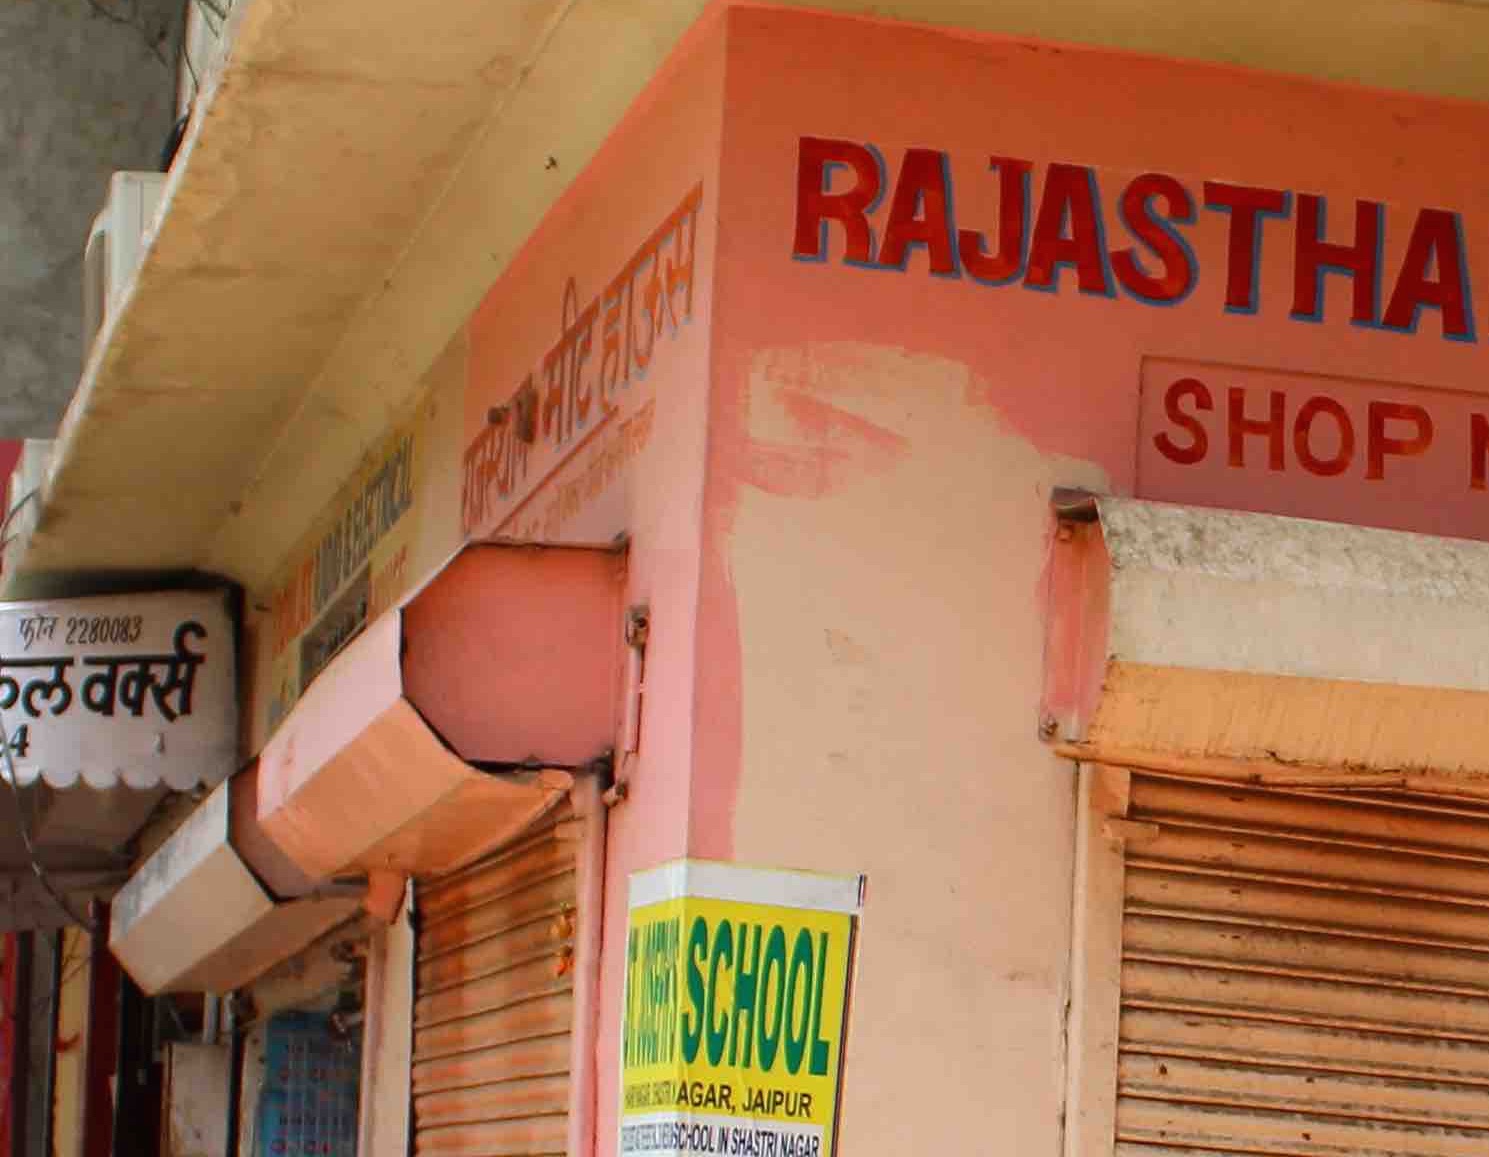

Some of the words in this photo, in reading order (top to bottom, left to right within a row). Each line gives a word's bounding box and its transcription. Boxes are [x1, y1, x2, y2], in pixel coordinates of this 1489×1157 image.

[1153, 377, 1434, 480] SHOP
[65, 614, 143, 645] 2280083
[681, 916, 831, 1076] SCHOOL
[742, 1086, 813, 1119] JAIPUR
[673, 1122, 715, 1151] SCHOOL
[717, 1126, 730, 1152] IN
[730, 1126, 778, 1157] SHASTRI
[777, 1131, 820, 1157] NAGAR
